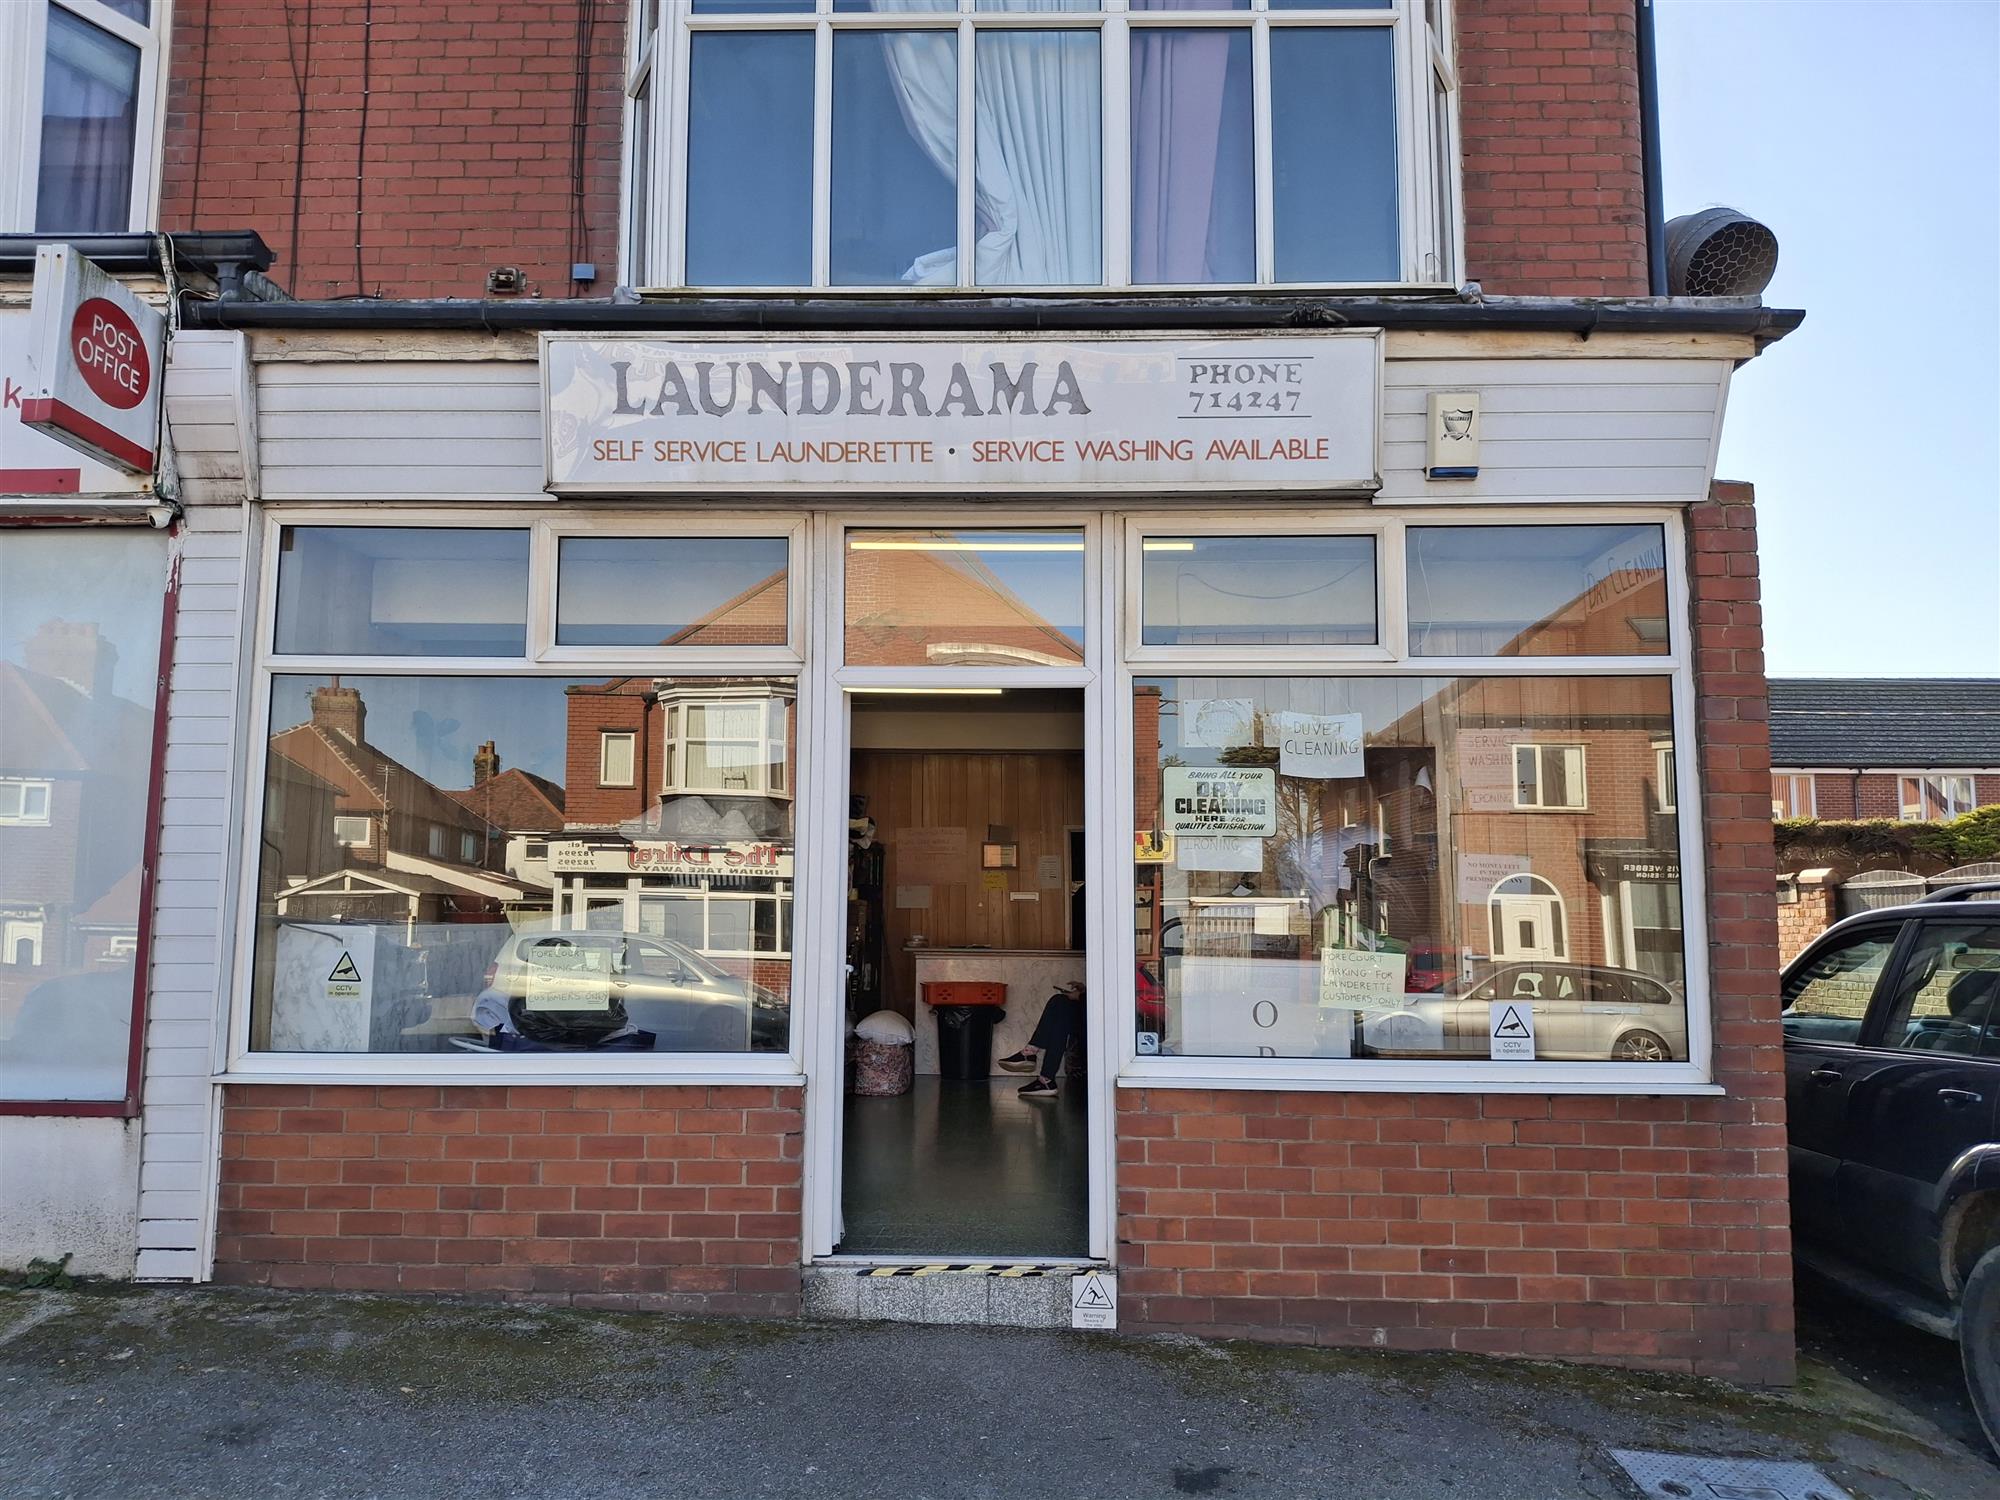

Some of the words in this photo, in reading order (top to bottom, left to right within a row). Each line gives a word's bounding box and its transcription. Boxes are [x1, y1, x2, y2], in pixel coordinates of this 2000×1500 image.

[92, 314, 138, 361] POST
[78, 336, 141, 395] OFFICE
[1189, 362, 1303, 386] PHONE
[610, 360, 1092, 417] LAUNDERAMA
[1188, 390, 1302, 413] 714247
[593, 439, 644, 462] SELF
[654, 440, 746, 462] SERVICE
[756, 440, 933, 463] LAUNDERETTE
[972, 439, 1065, 463] SERVICE
[1076, 438, 1193, 462] WASHING
[1205, 437, 1329, 461] AVAILABLE
[1607, 543, 1664, 594] CLEANIN
[1293, 720, 1345, 736] DUVET
[1284, 739, 1360, 756] CLEANING
[1187, 771, 1218, 779] BRING
[1220, 770, 1237, 779] ALL
[1239, 772, 1264, 780] YOUR
[1196, 781, 1243, 798] DRY
[1174, 798, 1266, 815] CLEANING
[1174, 822, 1208, 831] QUALITY
[1211, 822, 1266, 831] SATISFACTION
[1375, 969, 1393, 979] FOR
[1252, 1000, 1278, 1028] O
